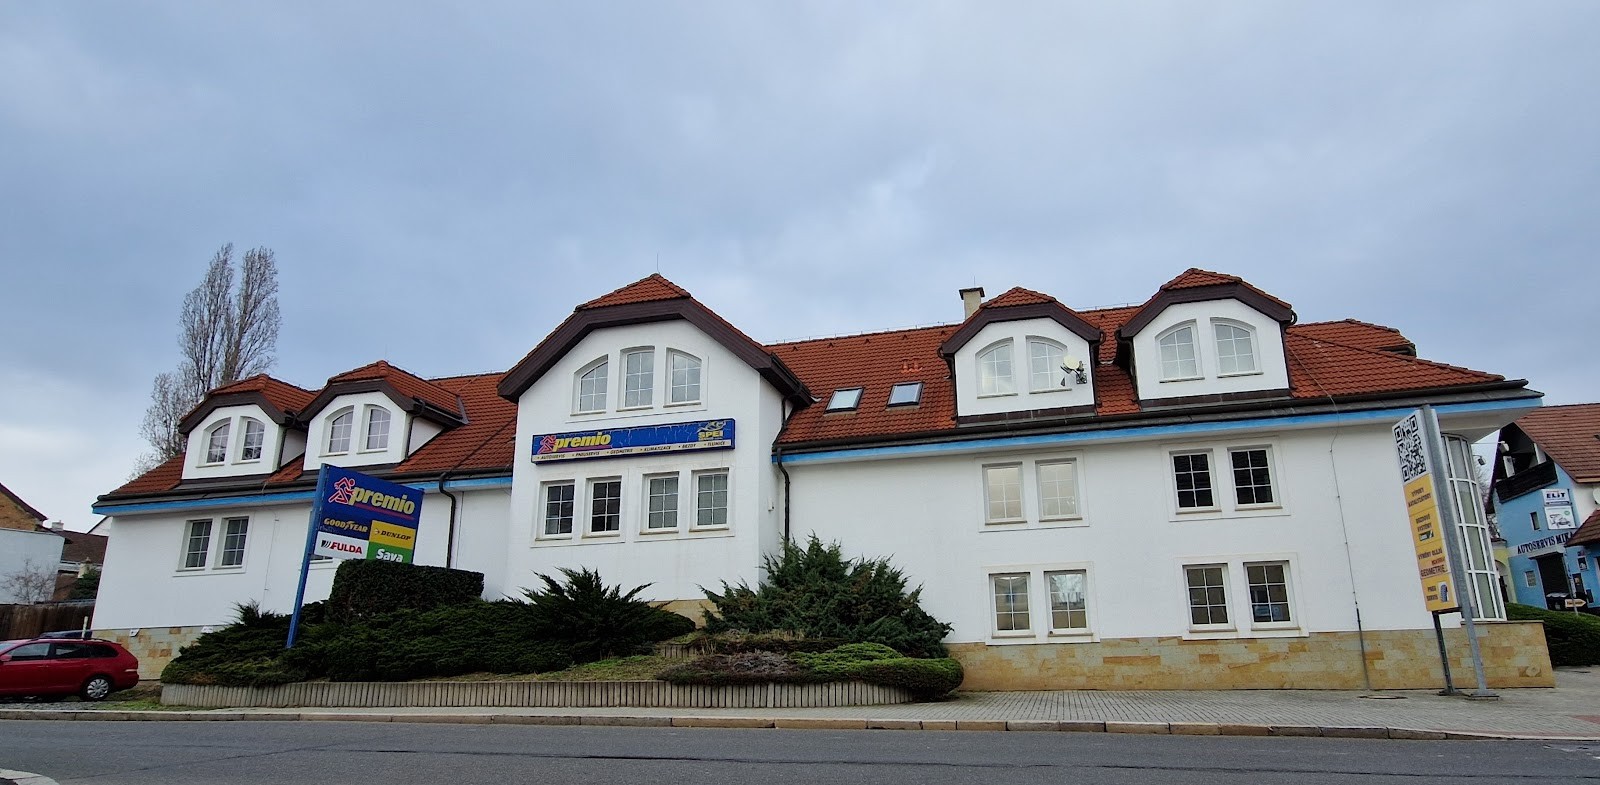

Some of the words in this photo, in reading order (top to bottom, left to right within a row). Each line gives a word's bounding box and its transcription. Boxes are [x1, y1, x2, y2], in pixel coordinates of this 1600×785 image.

[553, 432, 611, 452] premio
[348, 487, 415, 514] premio
[324, 518, 368, 532] GOODYEAR
[380, 530, 411, 541] DUNLOP
[330, 541, 362, 554] FULDA
[1517, 536, 1555, 554] AUTOSERVIS
[376, 548, 403, 562] Sava
